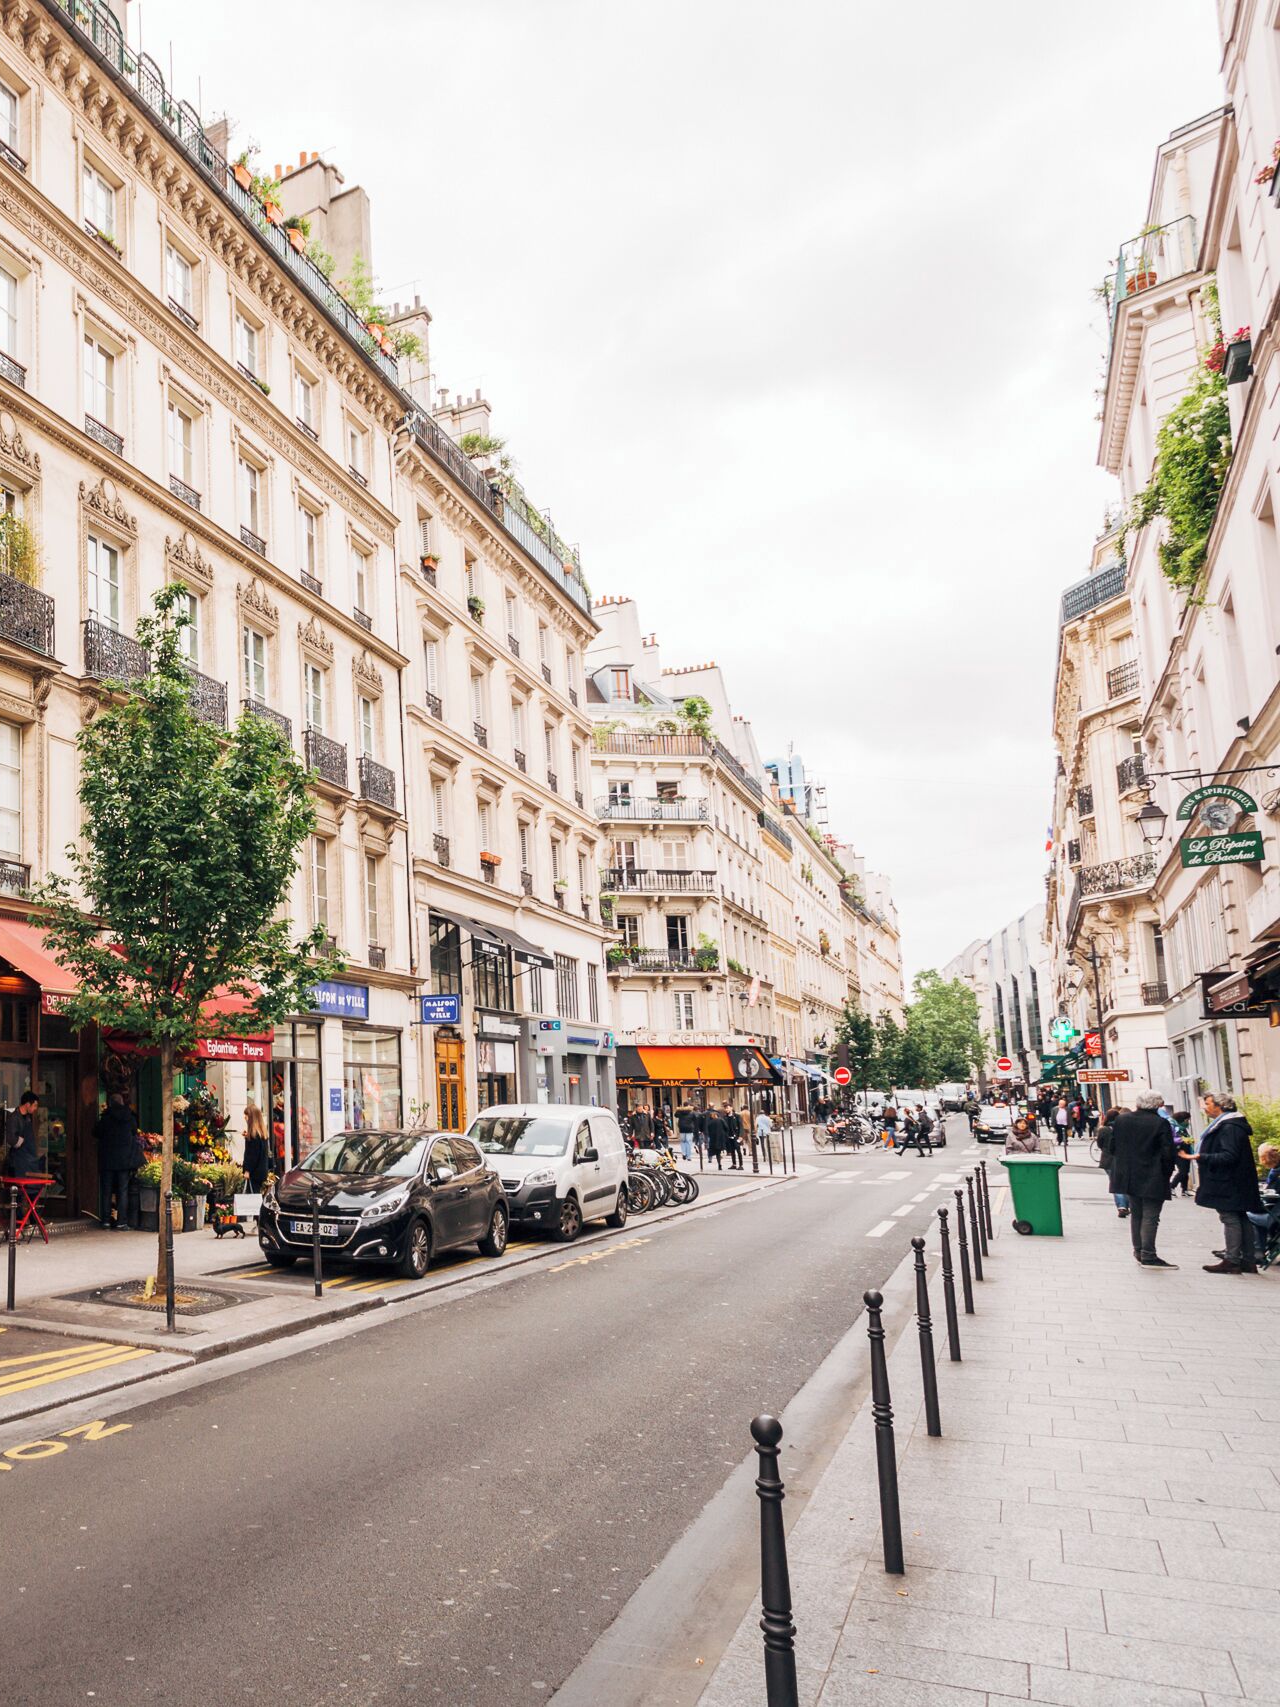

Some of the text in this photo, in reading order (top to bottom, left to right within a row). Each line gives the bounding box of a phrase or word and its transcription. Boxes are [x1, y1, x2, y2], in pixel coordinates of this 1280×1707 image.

[1180, 787, 1254, 816] VINS & SPIRITUEUX
[1187, 837, 1257, 853] Le Repaire
[1188, 849, 1255, 865] de Bacchus
[345, 995, 365, 1009] VILLE
[206, 1040, 264, 1057] Eglantine Fleurs
[662, 1079, 685, 1087] TABAC
